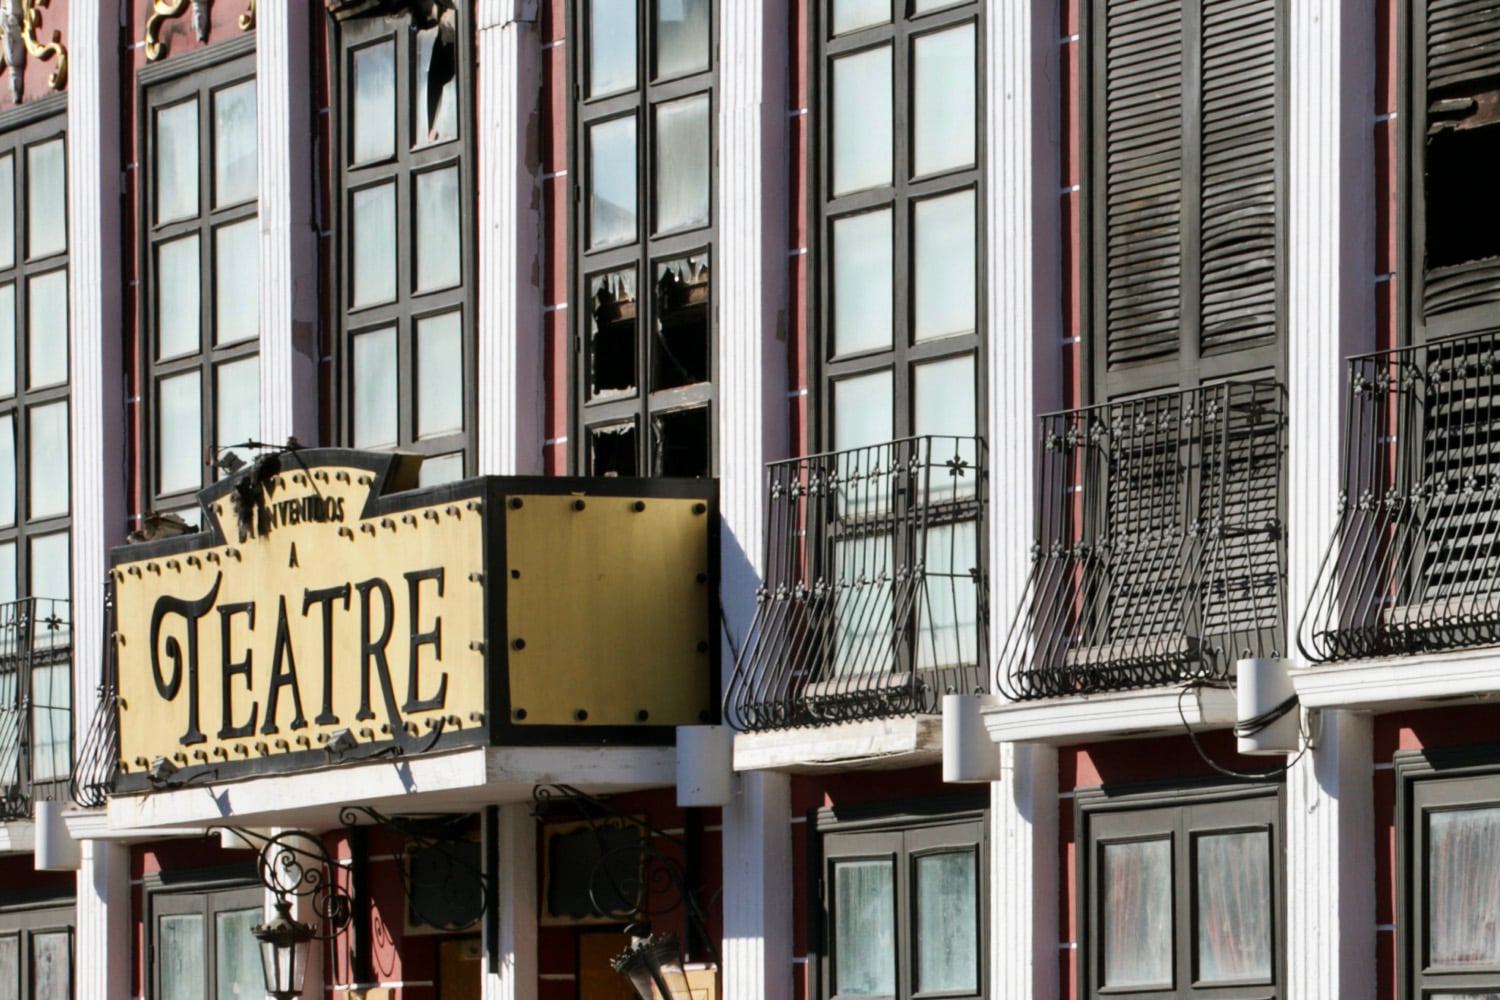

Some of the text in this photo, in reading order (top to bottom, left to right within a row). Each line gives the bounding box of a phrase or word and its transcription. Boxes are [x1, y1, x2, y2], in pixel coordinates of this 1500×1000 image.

[239, 495, 346, 543] INVENIDOS
[288, 541, 300, 568] A
[149, 566, 449, 752] TEATRE
